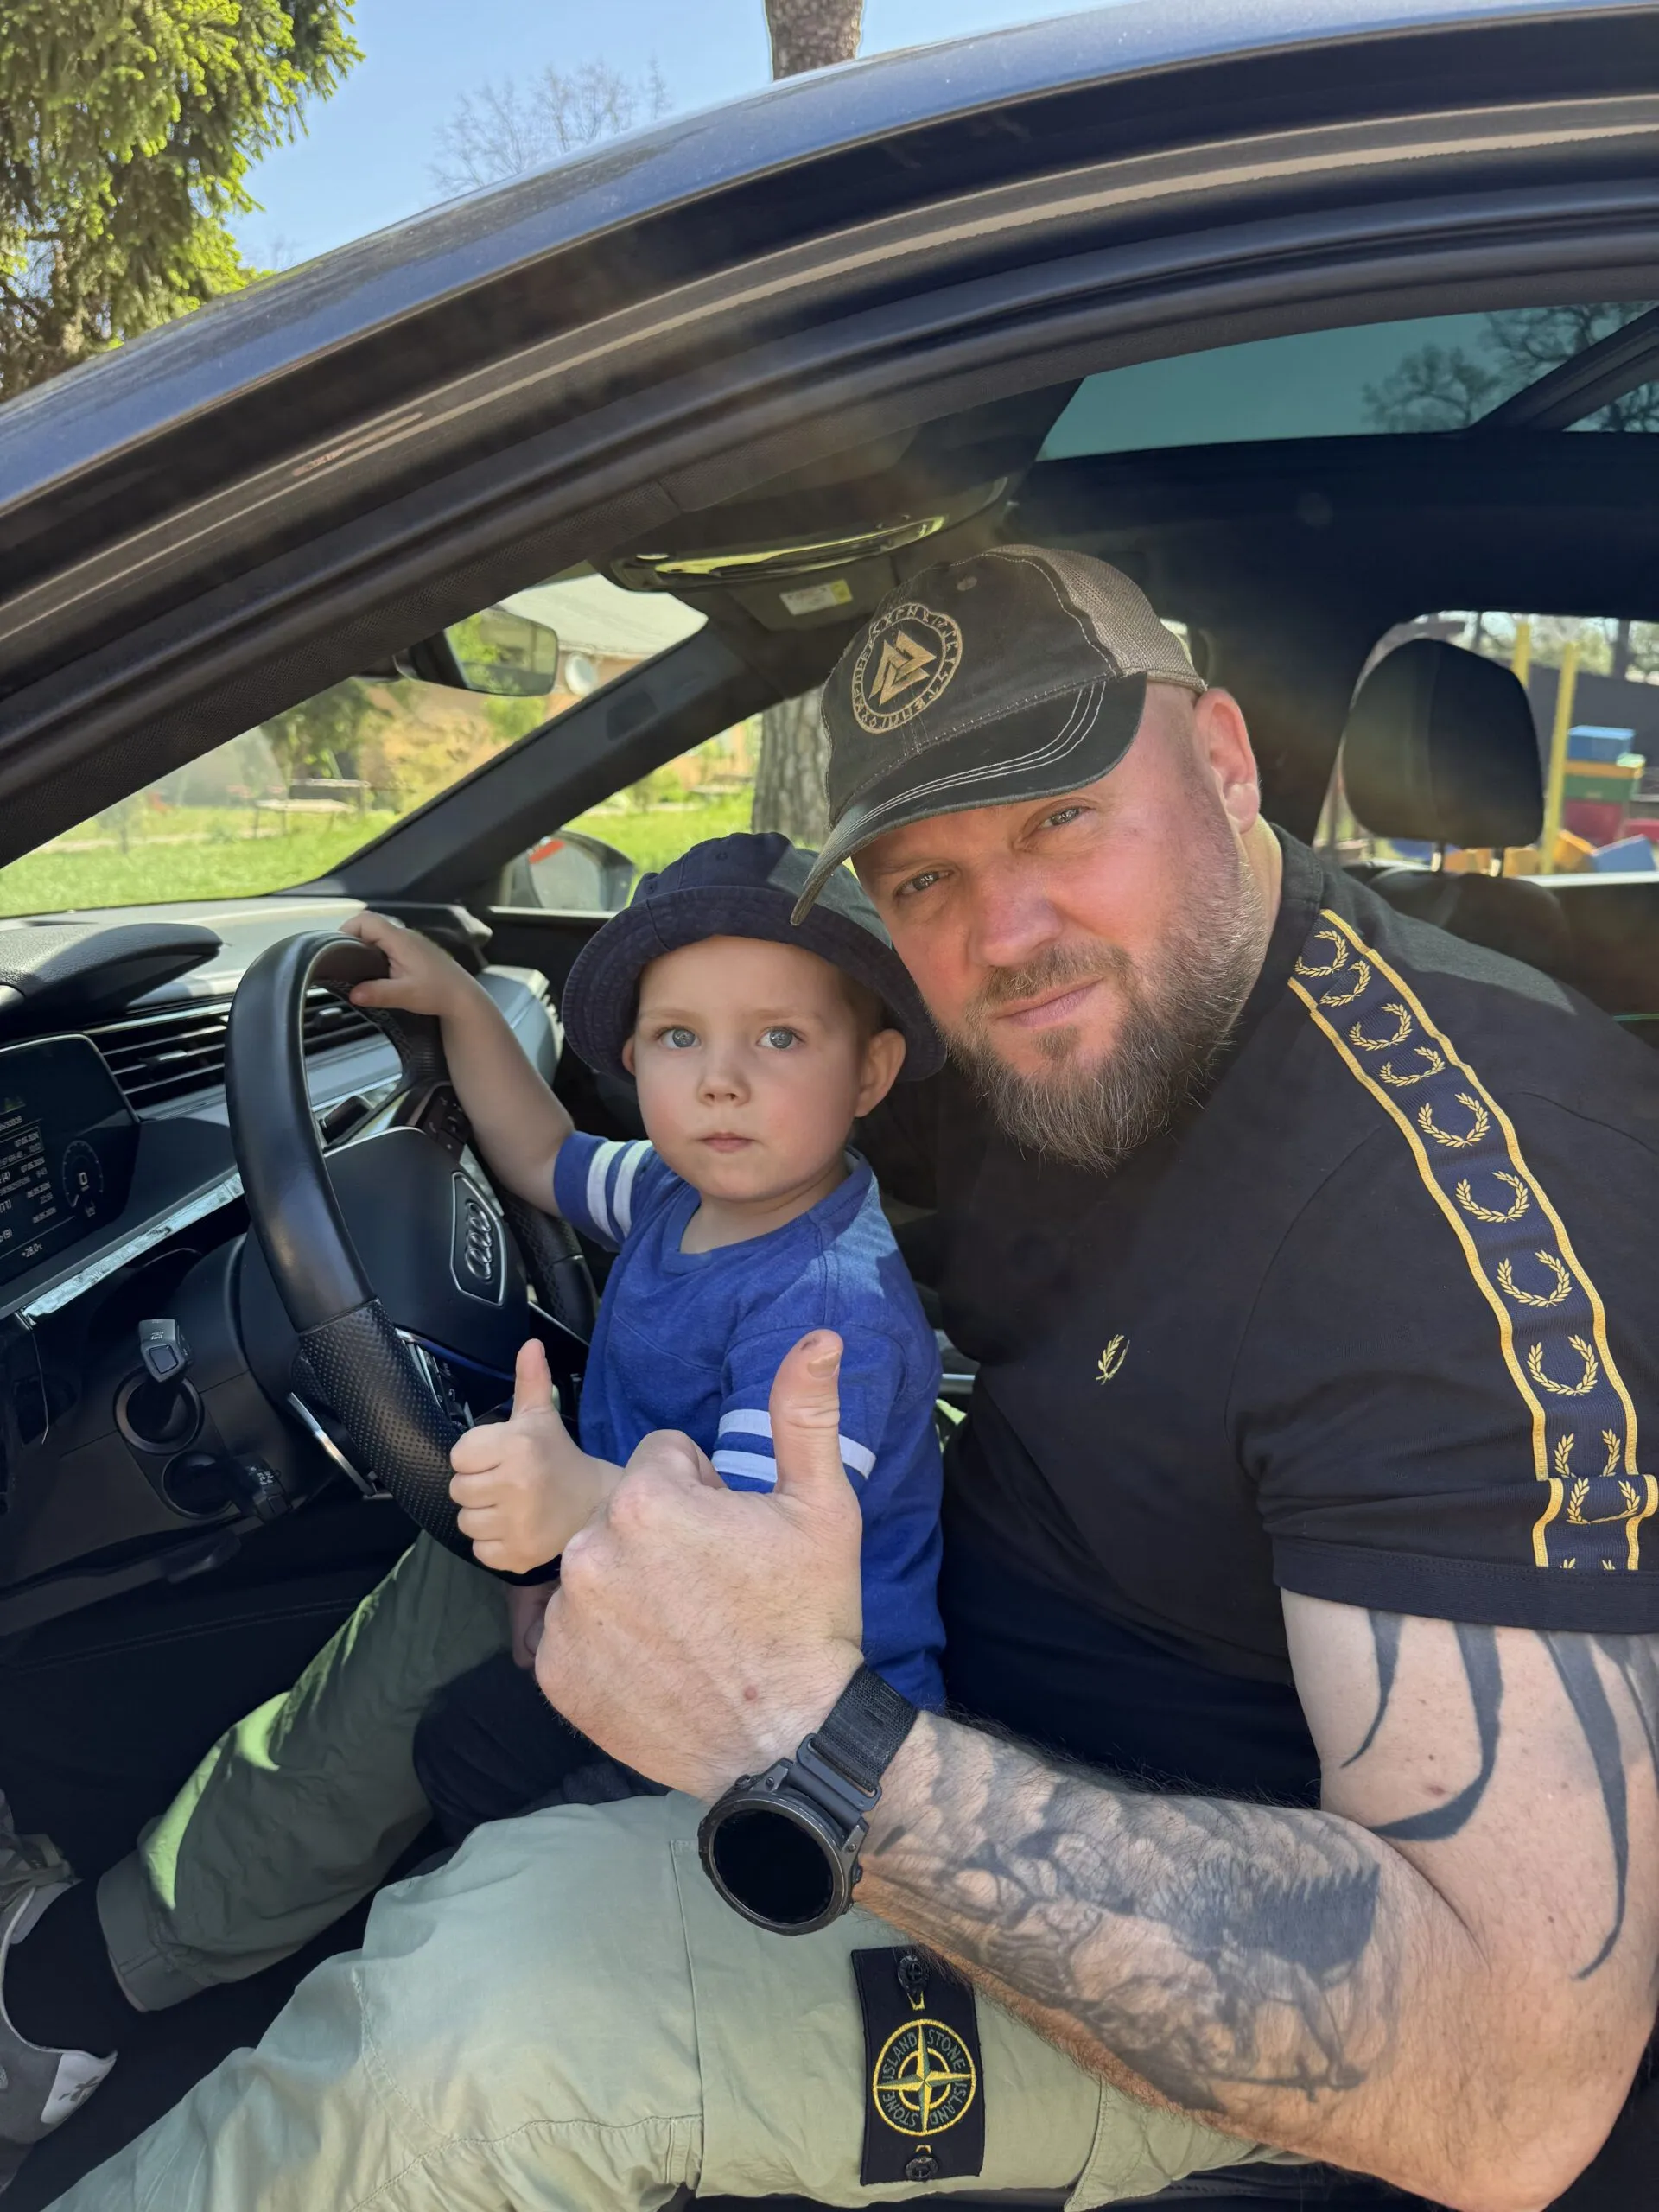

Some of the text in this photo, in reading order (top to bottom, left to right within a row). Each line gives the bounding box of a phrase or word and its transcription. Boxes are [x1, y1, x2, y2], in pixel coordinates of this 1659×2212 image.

[79, 1172, 88, 1185] 0
[881, 2031, 919, 2127] STONE ISLAND
[927, 2028, 968, 2126] STONE ISLAND
